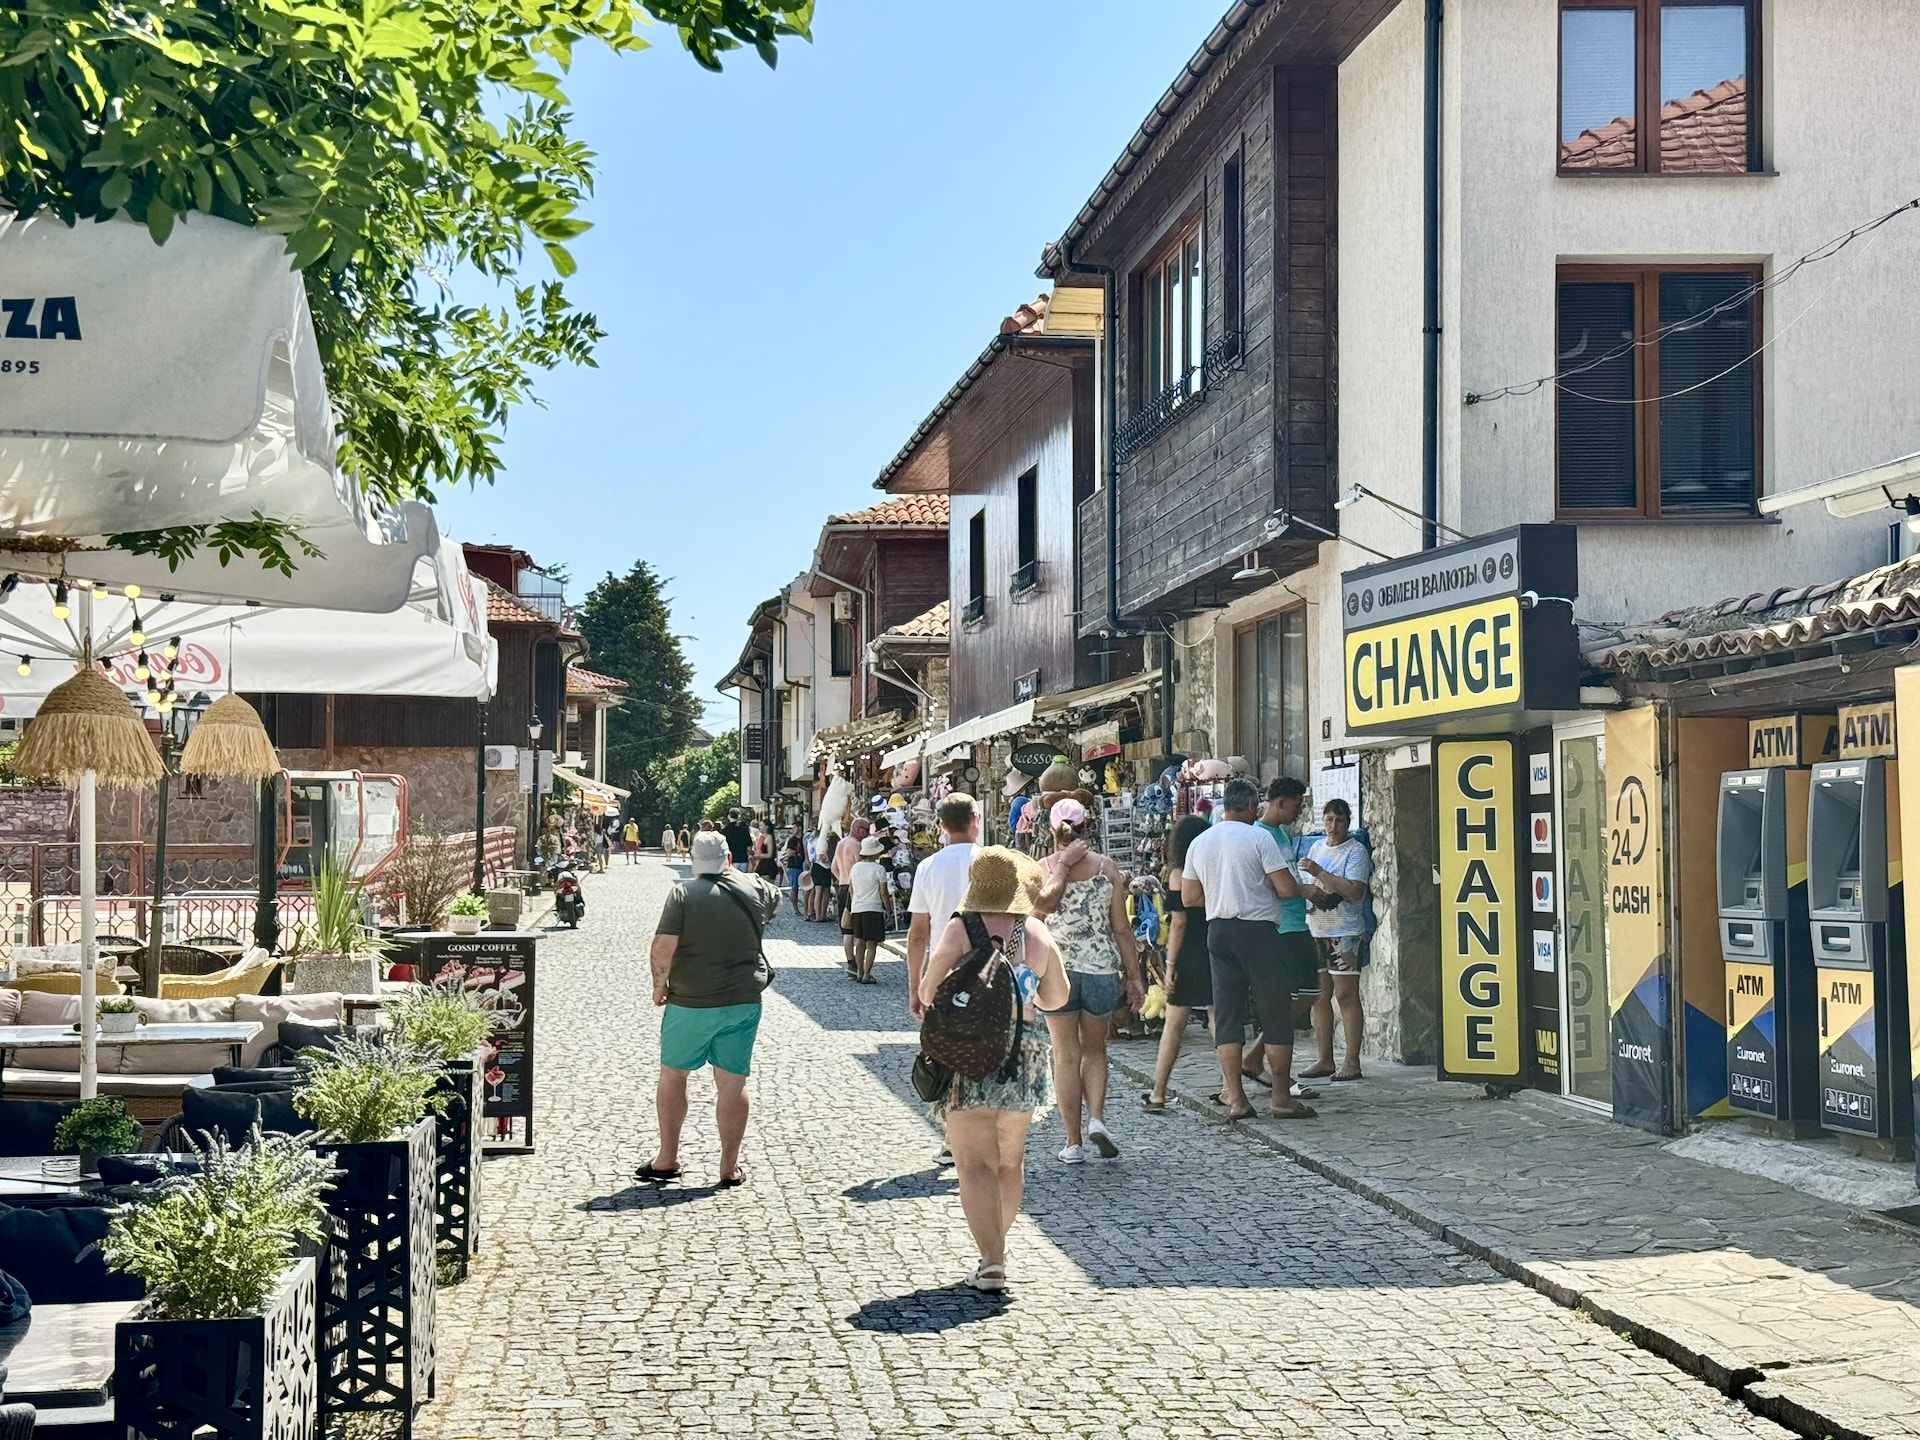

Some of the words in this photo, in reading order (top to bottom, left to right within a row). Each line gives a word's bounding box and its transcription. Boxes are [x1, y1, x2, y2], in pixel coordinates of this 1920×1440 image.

[0, 296, 82, 341] ZA
[1, 360, 40, 374] 895
[1378, 579, 1419, 607] ОБМЕН
[1422, 564, 1477, 598] ВАЛЮТЫ
[1352, 613, 1513, 712] CHANGE
[1752, 725, 1793, 759] ATM
[1843, 712, 1891, 749] ATM
[1533, 766, 1548, 782] VISA
[1612, 828, 1631, 866] 24
[1455, 755, 1501, 1060] CHANGE
[1612, 885, 1650, 914] CASH
[447, 943, 480, 952] GOSSIP
[481, 943, 518, 952] COFFEE
[1536, 942, 1551, 957] VISA
[1736, 974, 1764, 997] ATM
[1830, 981, 1862, 1005] ATM
